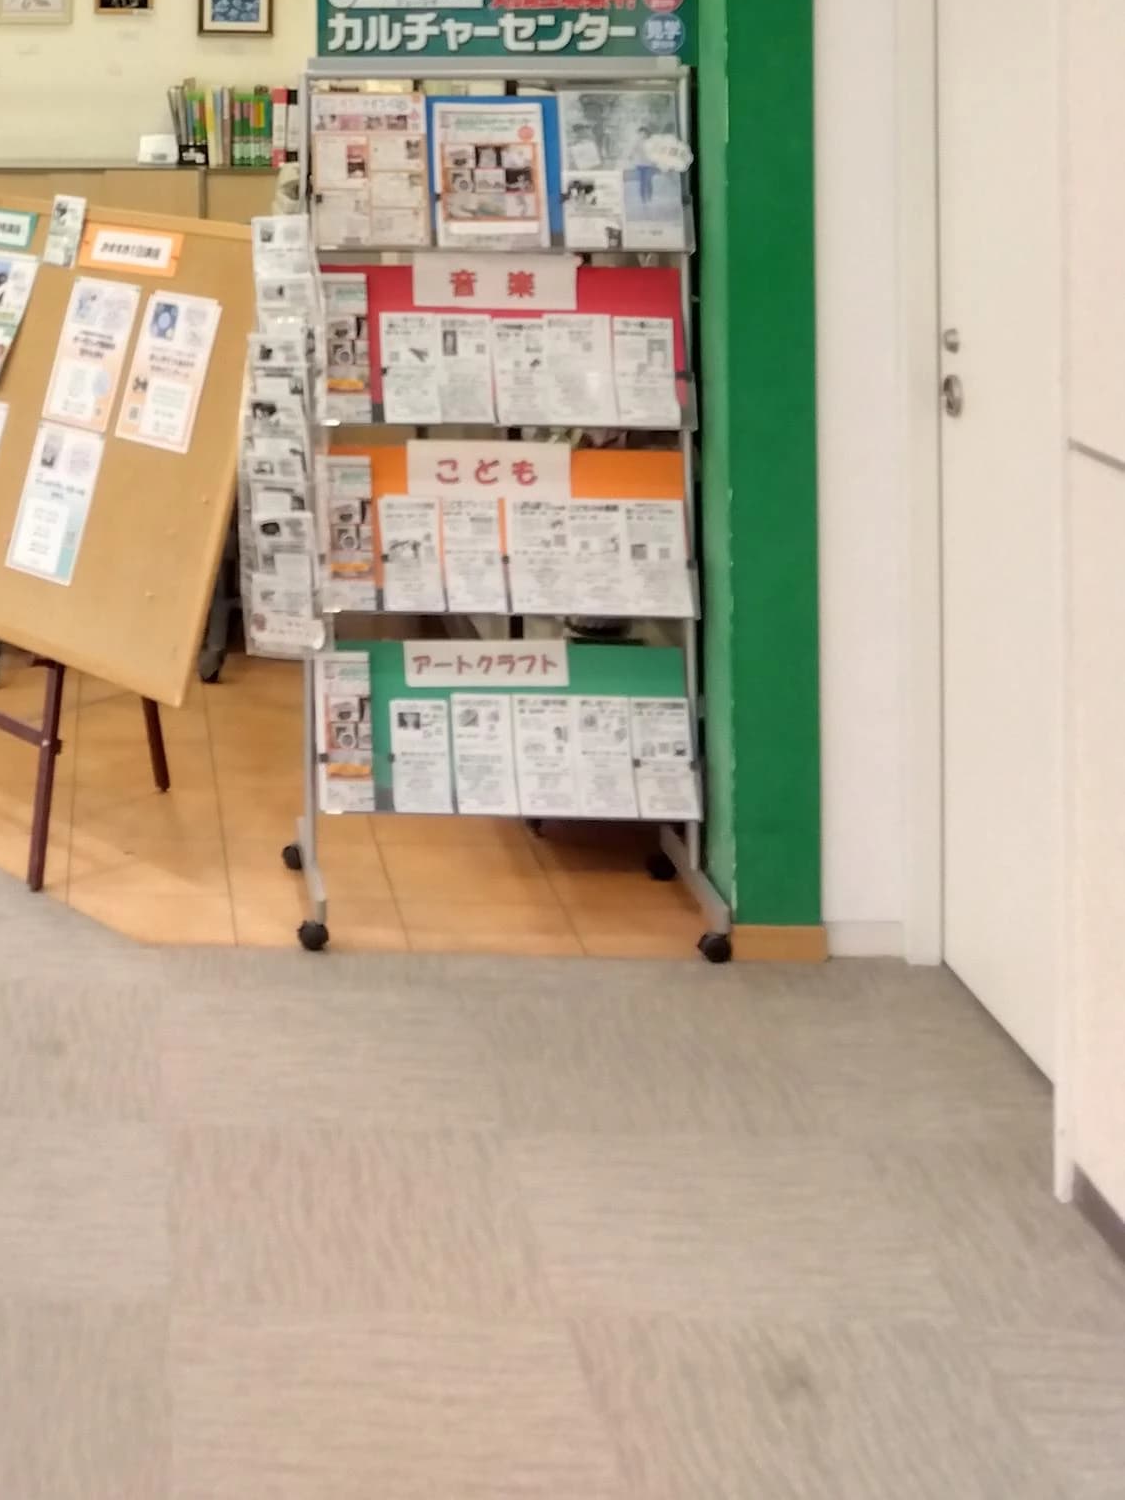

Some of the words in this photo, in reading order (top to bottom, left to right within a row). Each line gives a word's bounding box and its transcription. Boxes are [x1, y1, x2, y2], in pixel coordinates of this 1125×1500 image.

[327, 12, 637, 52] カルチャーセンター
[435, 459, 539, 486] こども
[412, 653, 560, 677] アートクラフト
